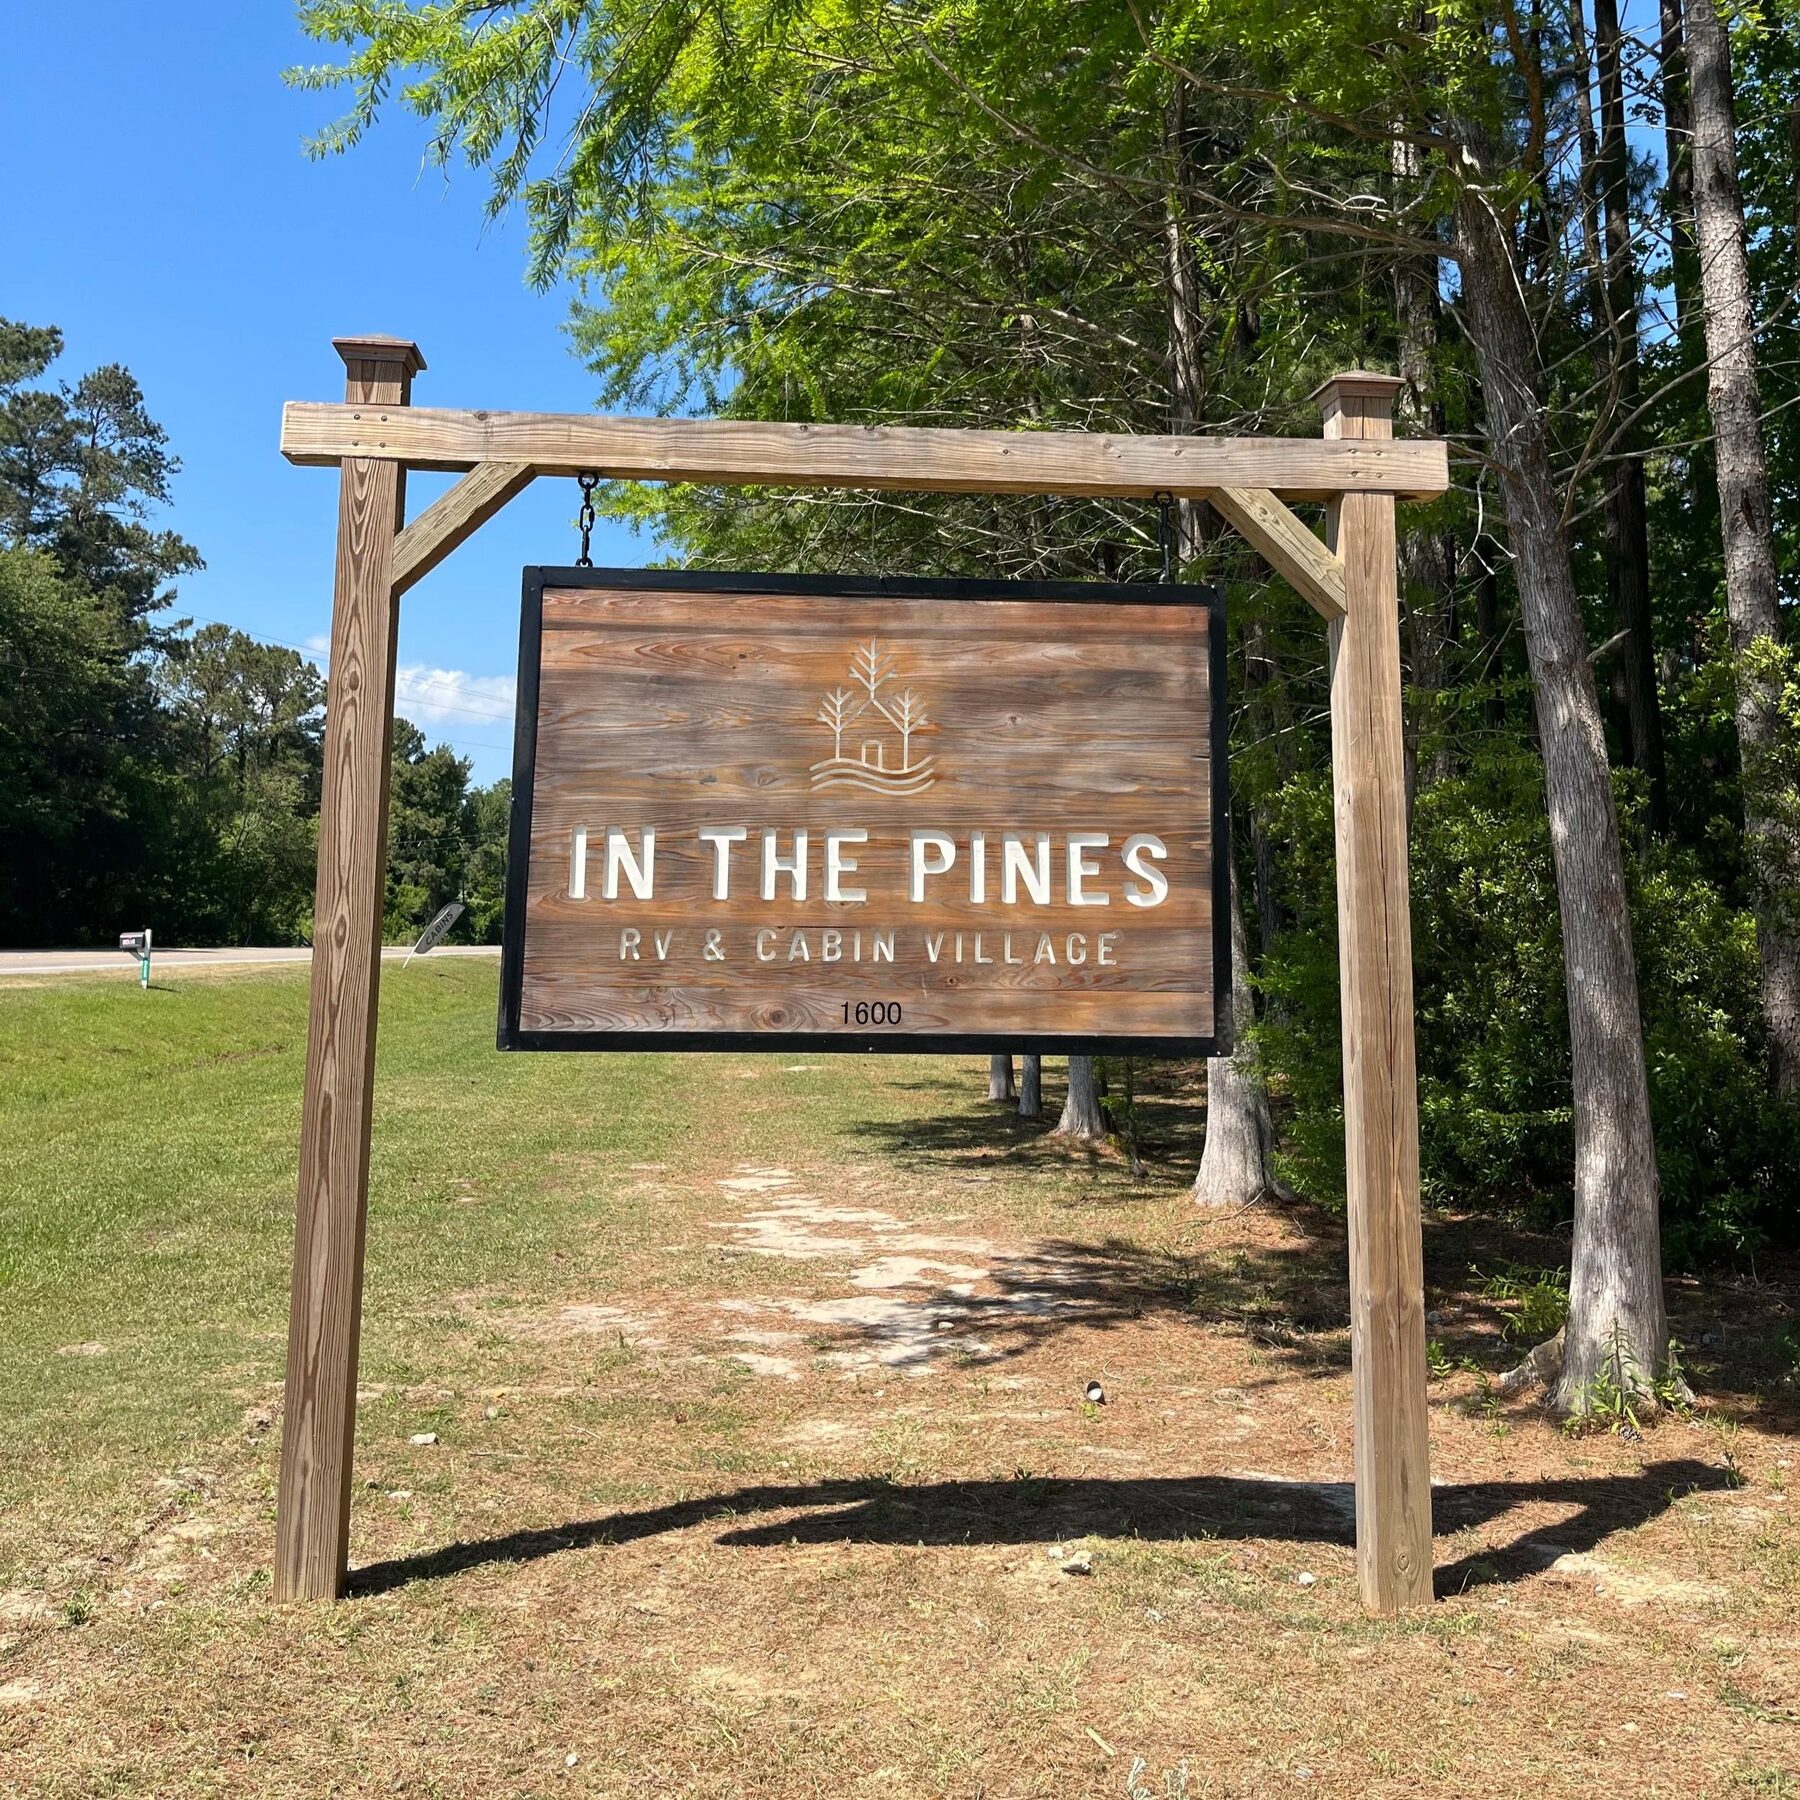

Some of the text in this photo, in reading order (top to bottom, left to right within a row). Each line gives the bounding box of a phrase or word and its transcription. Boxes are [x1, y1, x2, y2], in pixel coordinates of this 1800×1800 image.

[569, 825, 1169, 907] IN THE PINES
[425, 910, 454, 946] CABINS
[620, 927, 1118, 966] RV & CABIN VILLAGE
[841, 1001, 902, 1026] 1600
